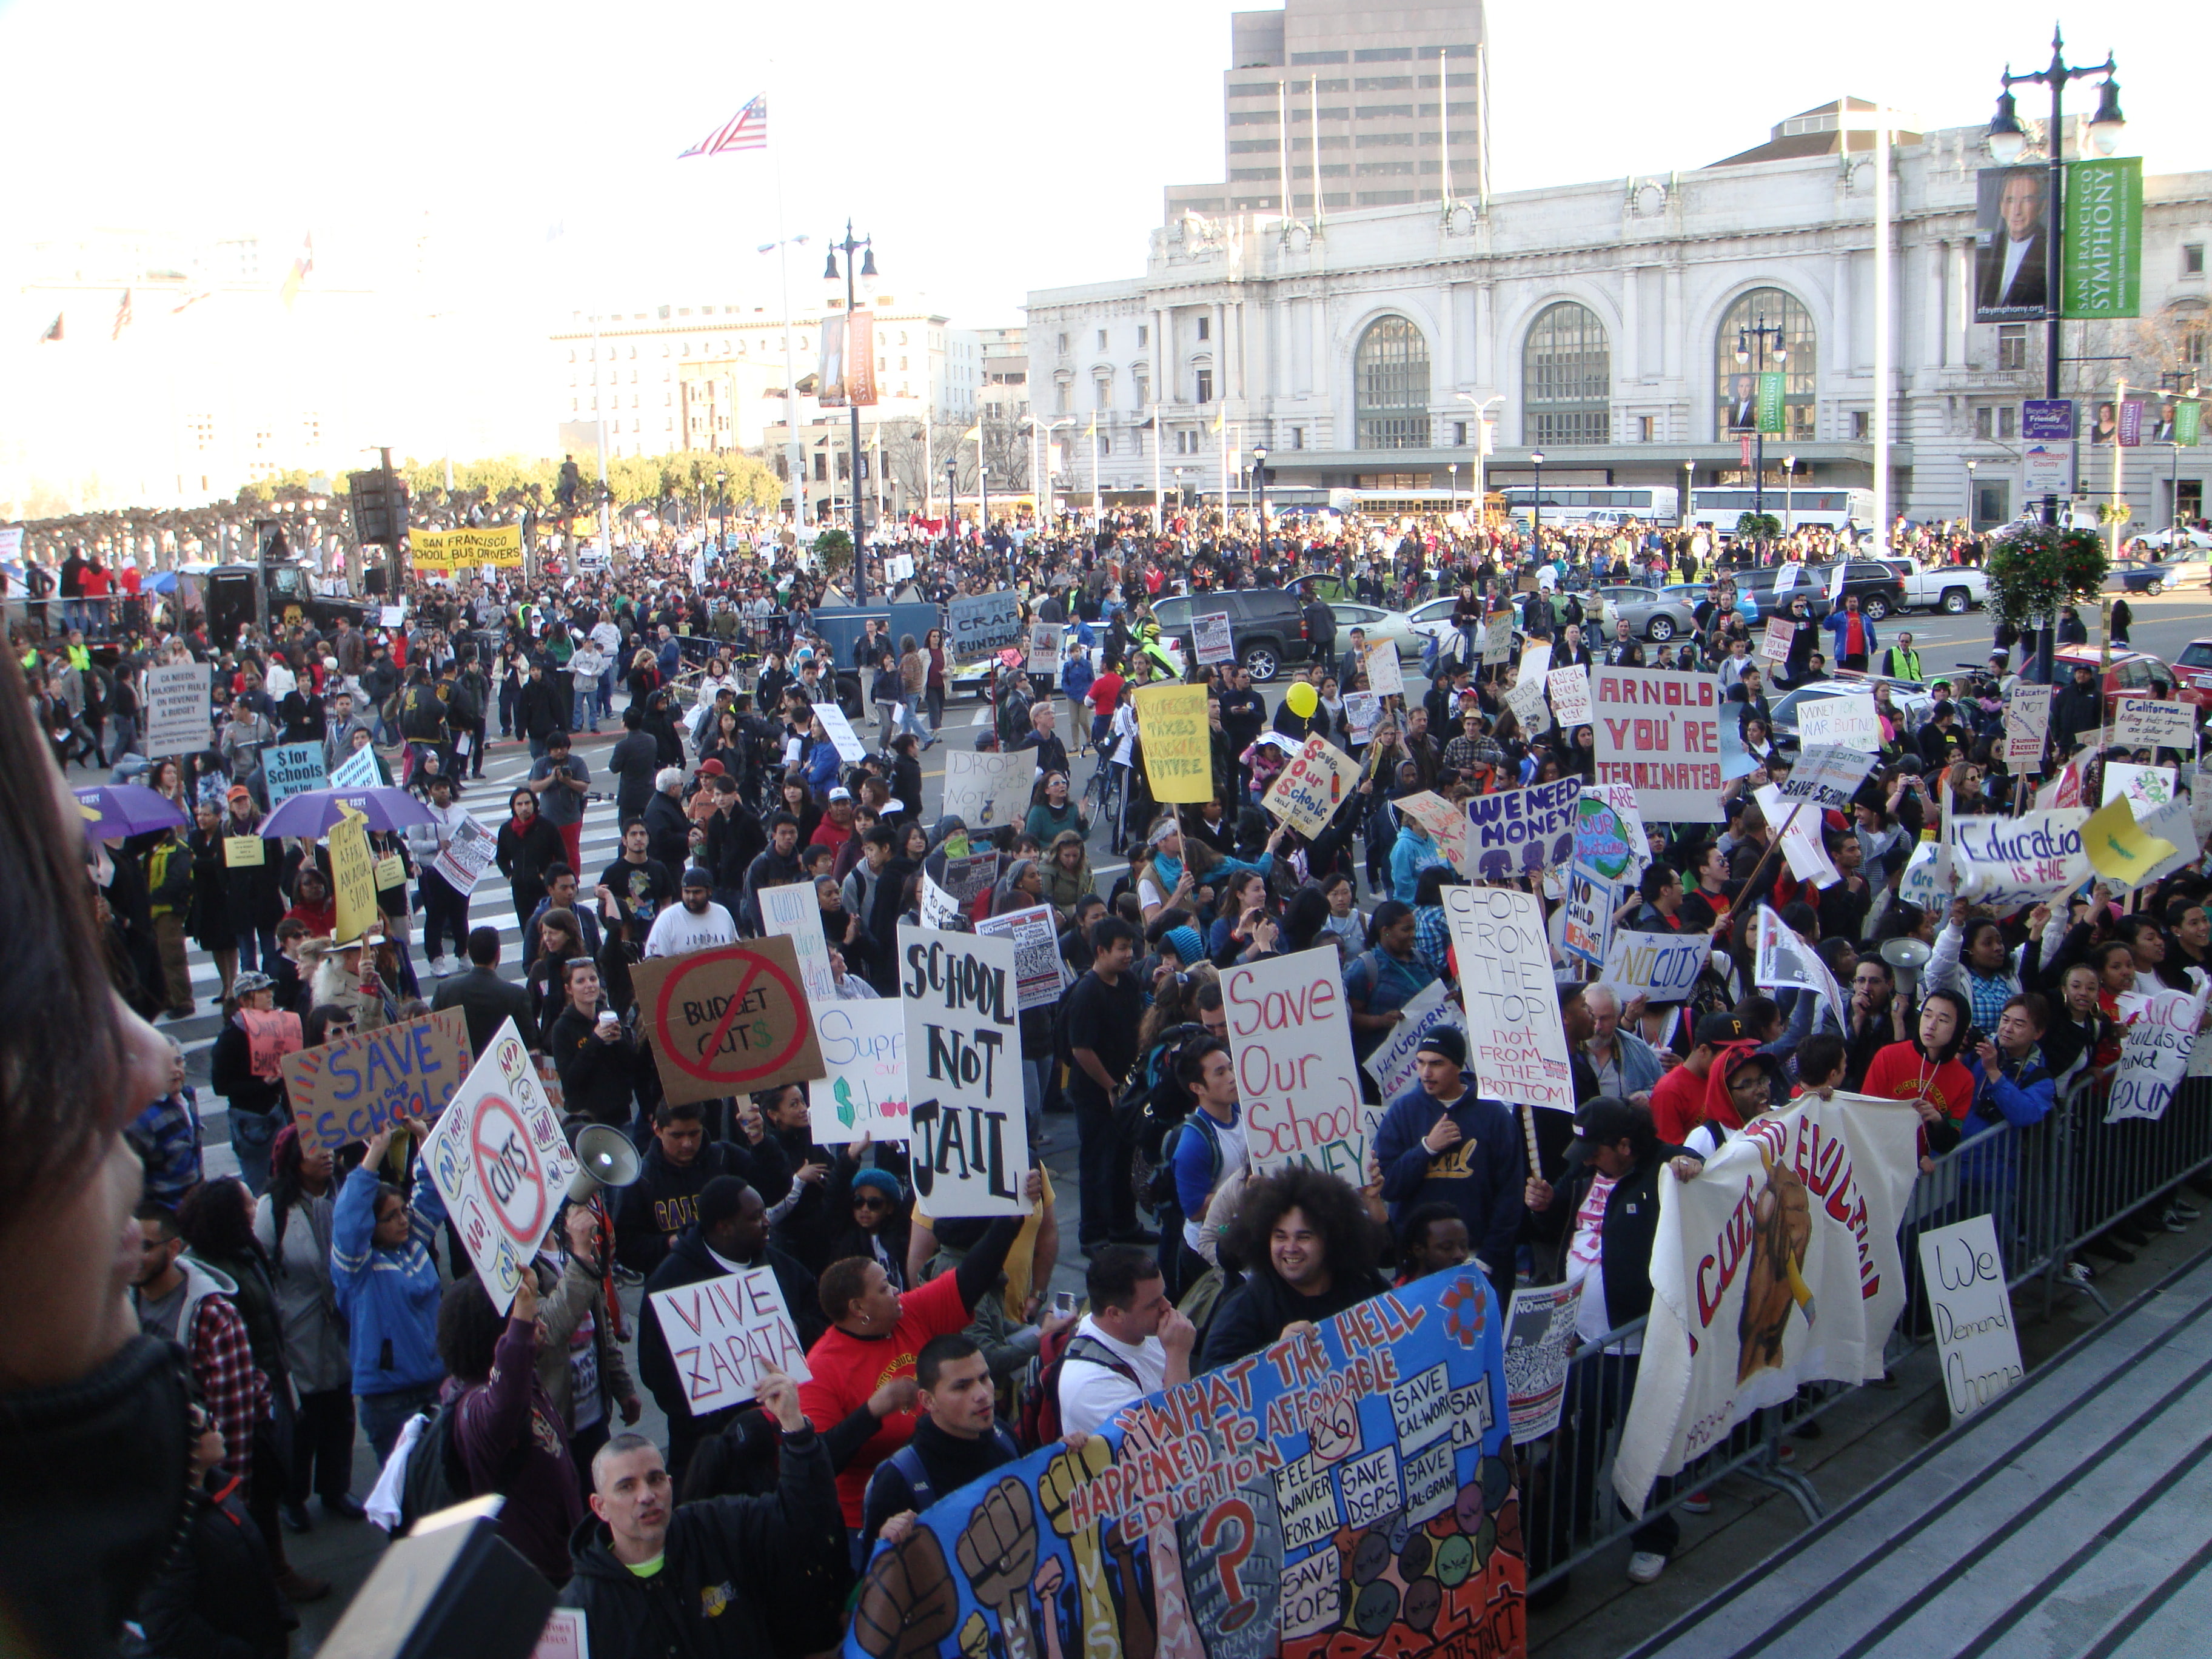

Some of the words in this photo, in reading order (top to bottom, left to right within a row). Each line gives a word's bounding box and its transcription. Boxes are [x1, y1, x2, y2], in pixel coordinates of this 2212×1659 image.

[2078, 169, 2092, 270] FRANCISCO
[2091, 167, 2114, 310] SYMPHONY
[1977, 304, 2044, 316] sfsymphony.org
[2078, 280, 2090, 310] SAN
[1768, 376, 1777, 430] SYMPHONY
[2029, 415, 2060, 423] Friendly
[2033, 423, 2070, 432] Community
[2125, 404, 2135, 444] SYMPHONY
[2025, 452, 2068, 460] StormReady
[412, 549, 446, 560] SCHOOL
[452, 548, 474, 559] BUS
[478, 547, 520, 559] DRIVERS
[423, 537, 443, 548] SAN
[447, 534, 507, 546] FRANCISCO
[172, 672, 196, 682] NEEDS
[1599, 677, 1714, 706] ARNOLD
[169, 695, 199, 705] REVENUE
[169, 707, 195, 716] BUDGET
[1800, 703, 1834, 720] MONEY
[2021, 702, 2043, 713] NOT
[2125, 700, 2190, 716] California...
[1603, 710, 1718, 753] YOU'RE
[1802, 720, 1830, 737] WAR
[1834, 718, 1858, 732] BUT
[1858, 718, 1874, 732] NO
[277, 751, 286, 766] $
[289, 750, 308, 764] for
[337, 751, 366, 782] Defend
[954, 752, 1019, 776] DROP
[1150, 758, 1204, 780] FUTURE
[1820, 760, 1845, 771] FUTURE
[1825, 751, 1867, 764] EDUCATION
[268, 763, 323, 784] Schools
[1597, 762, 1721, 790] TERMINATED
[1782, 780, 1815, 796] SAVE
[284, 786, 298, 795] Not
[300, 783, 312, 792] for
[1469, 791, 1522, 827] WE
[1526, 778, 1581, 816] NEED
[1609, 786, 1637, 808] ARE
[1275, 796, 1290, 808] and
[1304, 816, 1313, 825] us
[1481, 803, 1578, 848] MONEY!
[1960, 819, 2082, 863] Educatio
[341, 870, 351, 891] AN
[2012, 862, 2032, 883] is
[350, 882, 370, 912] SIGN
[930, 886, 938, 909] to
[1449, 889, 1530, 919] CHOP
[1572, 875, 1591, 905] NO
[981, 925, 994, 934] NO
[994, 922, 1012, 932] MORE
[1568, 901, 1594, 926] CHILD
[686, 933, 726, 945] JORDAN
[1457, 921, 1547, 962] FROM
[1475, 954, 1544, 991] THE
[1615, 945, 1658, 986] NO
[1650, 945, 1701, 988] CUTS
[903, 941, 1016, 1026] SCHOOL
[683, 988, 768, 1027] BUDGET
[1229, 971, 1335, 1035] Save
[1478, 991, 1558, 1028] TOP!
[820, 1009, 905, 1065] Supp
[1493, 1027, 1538, 1047] not
[1732, 1019, 1743, 1035] P
[327, 1025, 442, 1100] SAVE
[923, 1023, 1003, 1099] NOT
[1480, 1046, 1543, 1064] FROM
[1241, 1045, 1323, 1097] Our
[1499, 1063, 1541, 1081] THE
[1481, 1076, 1575, 1105] BOTTOM!
[1894, 1085, 1903, 1095] NO
[1903, 1079, 1920, 1090] CUTS
[317, 1079, 454, 1148] SCHOOLS
[490, 1131, 528, 1204] CUTS
[911, 1099, 1018, 1206] JAIL
[1697, 1175, 1754, 1328] CUTS
[1936, 1238, 1997, 1290] We
[665, 1272, 779, 1337] VIVE
[1516, 1302, 1533, 1315] NO
[1533, 1298, 1556, 1311] MORE
[1517, 1292, 1551, 1302] EDUCATION
[1935, 1295, 2009, 1345] Demand
[1266, 1328, 1332, 1385] THE
[1335, 1292, 1427, 1353] HELL
[675, 1315, 810, 1401] ZAPATA
[1394, 1368, 1443, 1414] SAVE
[1070, 1435, 1210, 1534] HAPPENED
[1216, 1406, 1262, 1455] TO
[1265, 1346, 1401, 1443] AFFORDABLE
[1276, 1459, 1309, 1492] FEE
[1341, 1455, 1389, 1493] SAVE
[1407, 1452, 1449, 1485] SAVE
[1121, 1438, 1286, 1544] EDUCATION
[1278, 1475, 1332, 1518] WAIVER
[1285, 1517, 1315, 1546] FOR
[1316, 1507, 1339, 1534] ALL
[1282, 1553, 1338, 1596] SAVE
